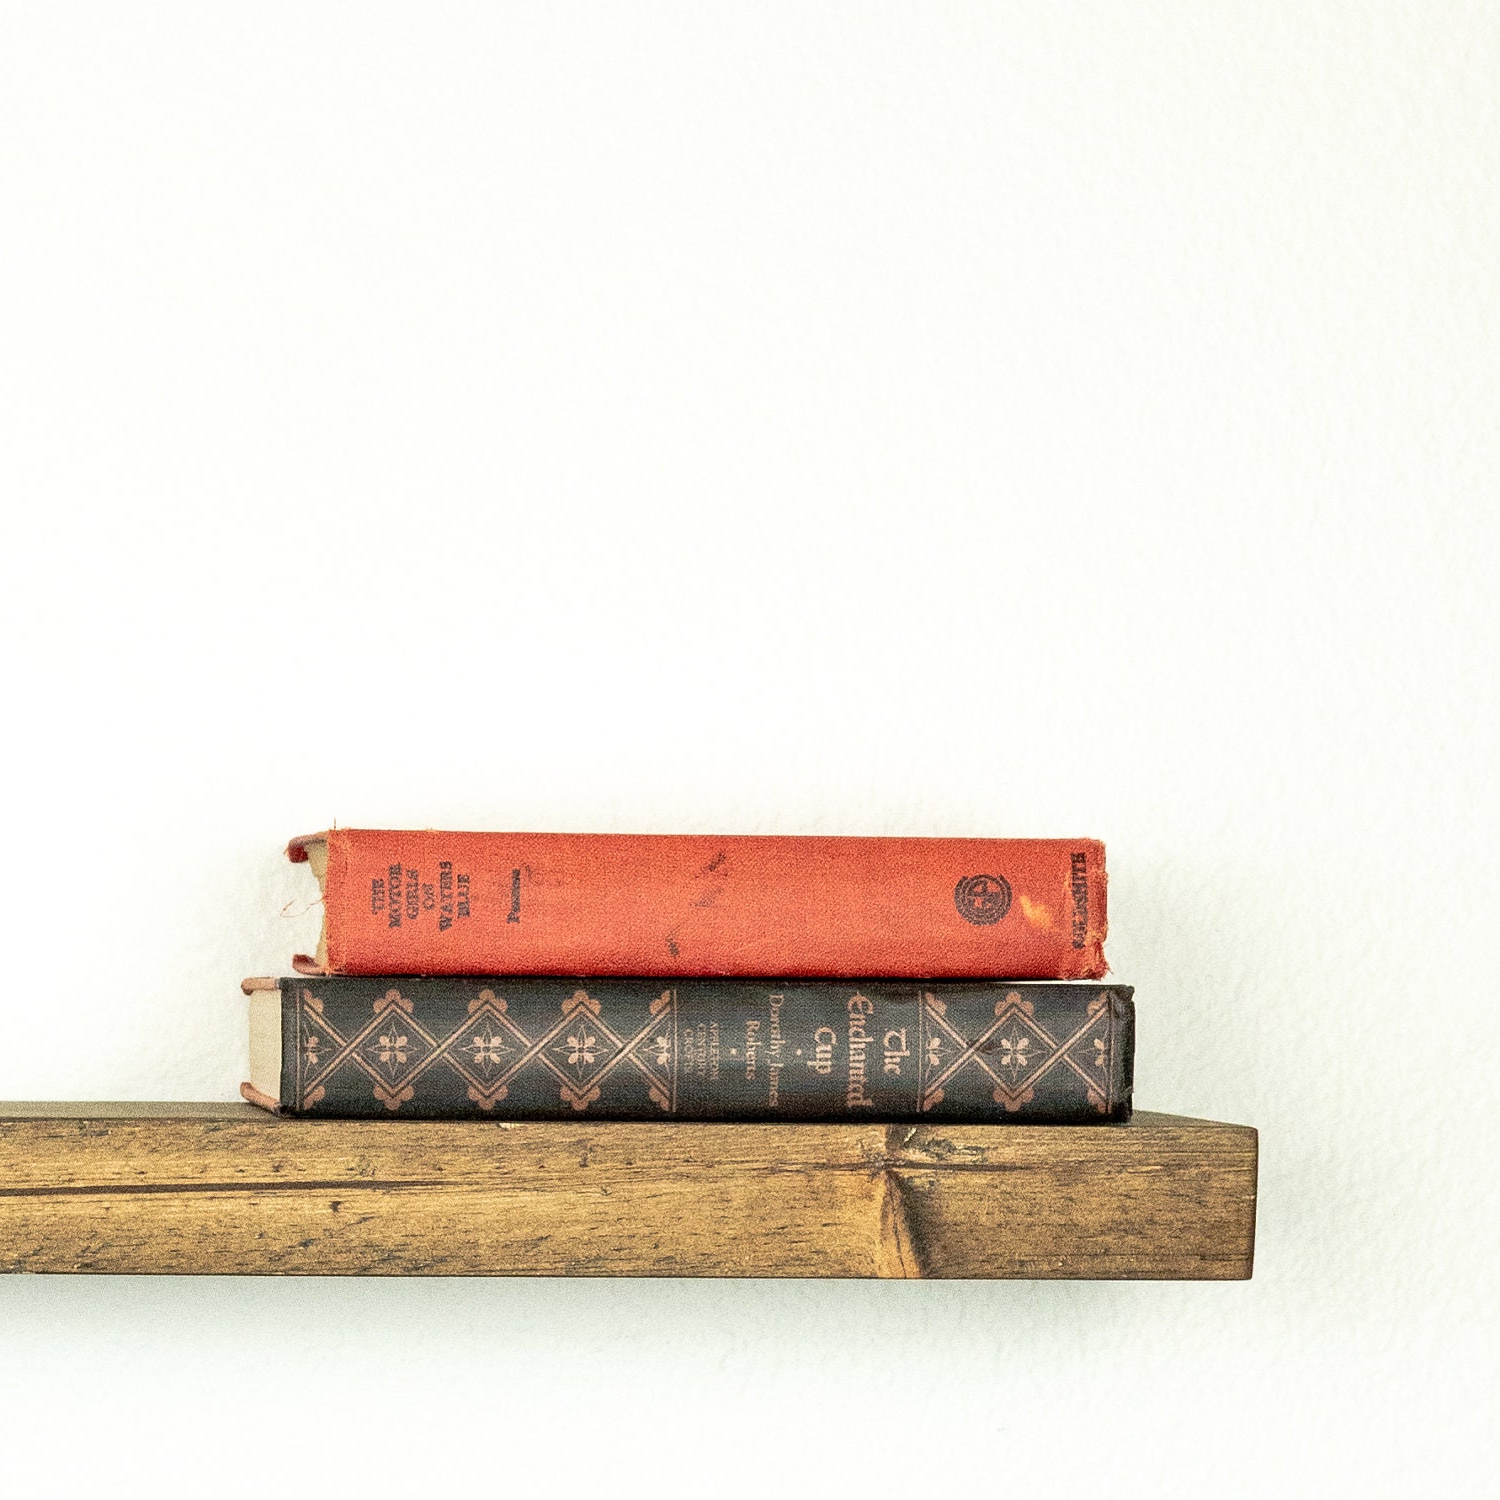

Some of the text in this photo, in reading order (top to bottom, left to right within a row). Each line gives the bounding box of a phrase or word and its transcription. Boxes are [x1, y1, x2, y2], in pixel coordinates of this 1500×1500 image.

[371, 878, 385, 915] THE
[388, 862, 402, 928] MOTOR
[405, 869, 419, 919] GIRLS
[422, 882, 435, 910] ON
[438, 861, 452, 931] WATERS
[457, 873, 470, 918] BLUE
[745, 1020, 762, 1080] Roberts
[766, 994, 786, 1107] Dorothy James
[806, 1026, 837, 1075] Cup
[847, 991, 874, 1108] Enchanted
[883, 1027, 911, 1075] The
